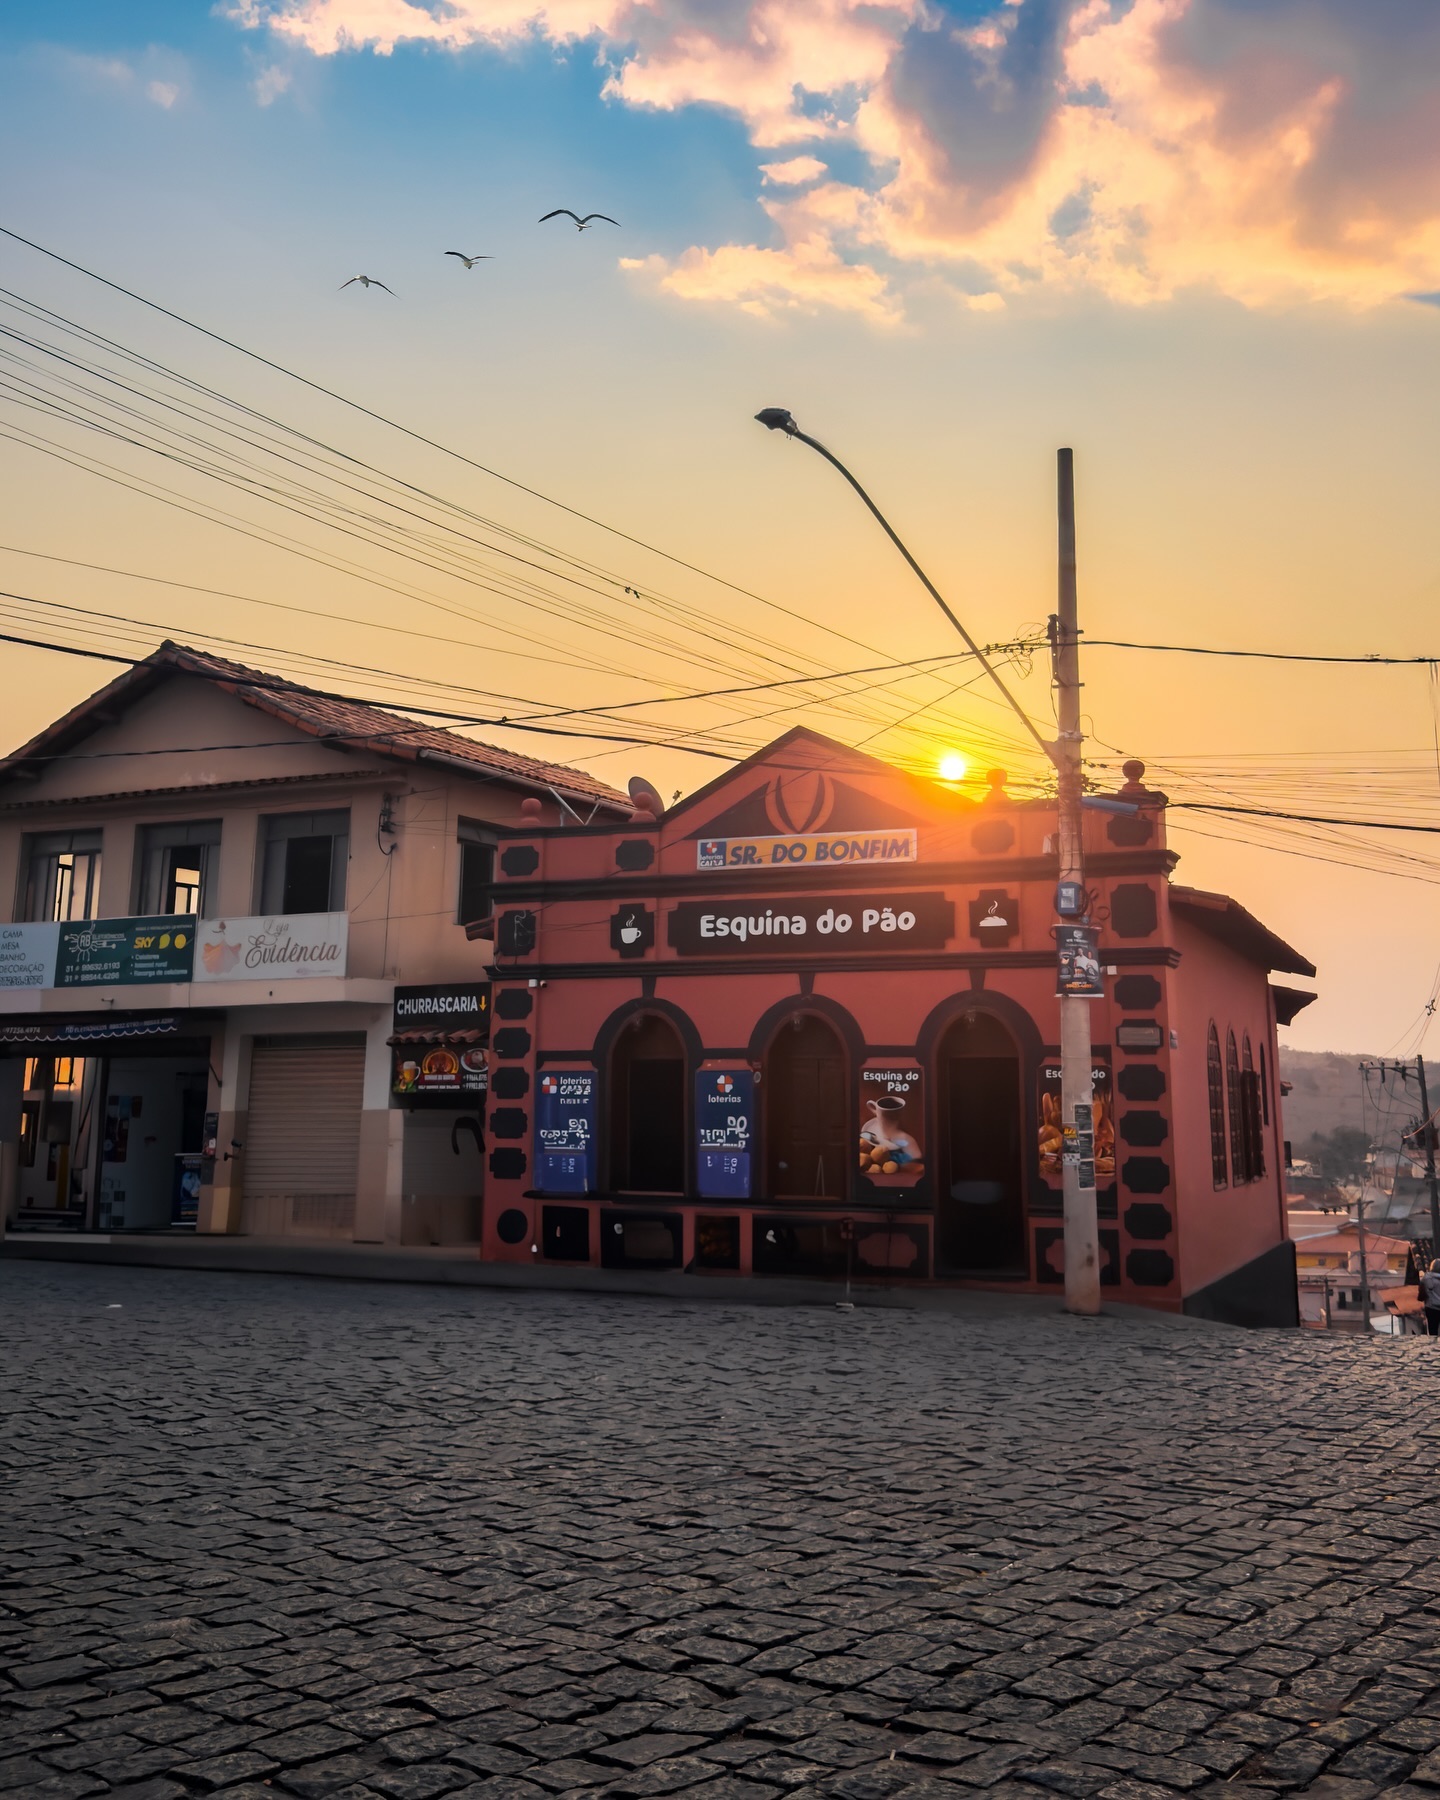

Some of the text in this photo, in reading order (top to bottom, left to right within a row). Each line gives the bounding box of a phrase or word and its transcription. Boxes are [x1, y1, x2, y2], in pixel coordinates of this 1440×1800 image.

[728, 838, 910, 865] SR. DO BONFIM
[700, 907, 916, 942] Esquina do Pão
[2, 930, 23, 939] CAMA
[1, 942, 19, 950] MESA
[133, 936, 156, 949] SKY
[245, 935, 342, 968] Evidência
[396, 996, 479, 1015] CHURRASCARIA
[560, 1076, 592, 1085] loterias
[863, 1071, 919, 1082] Esquina do
[887, 1081, 910, 1092] Pão
[708, 1094, 741, 1103] loterias
